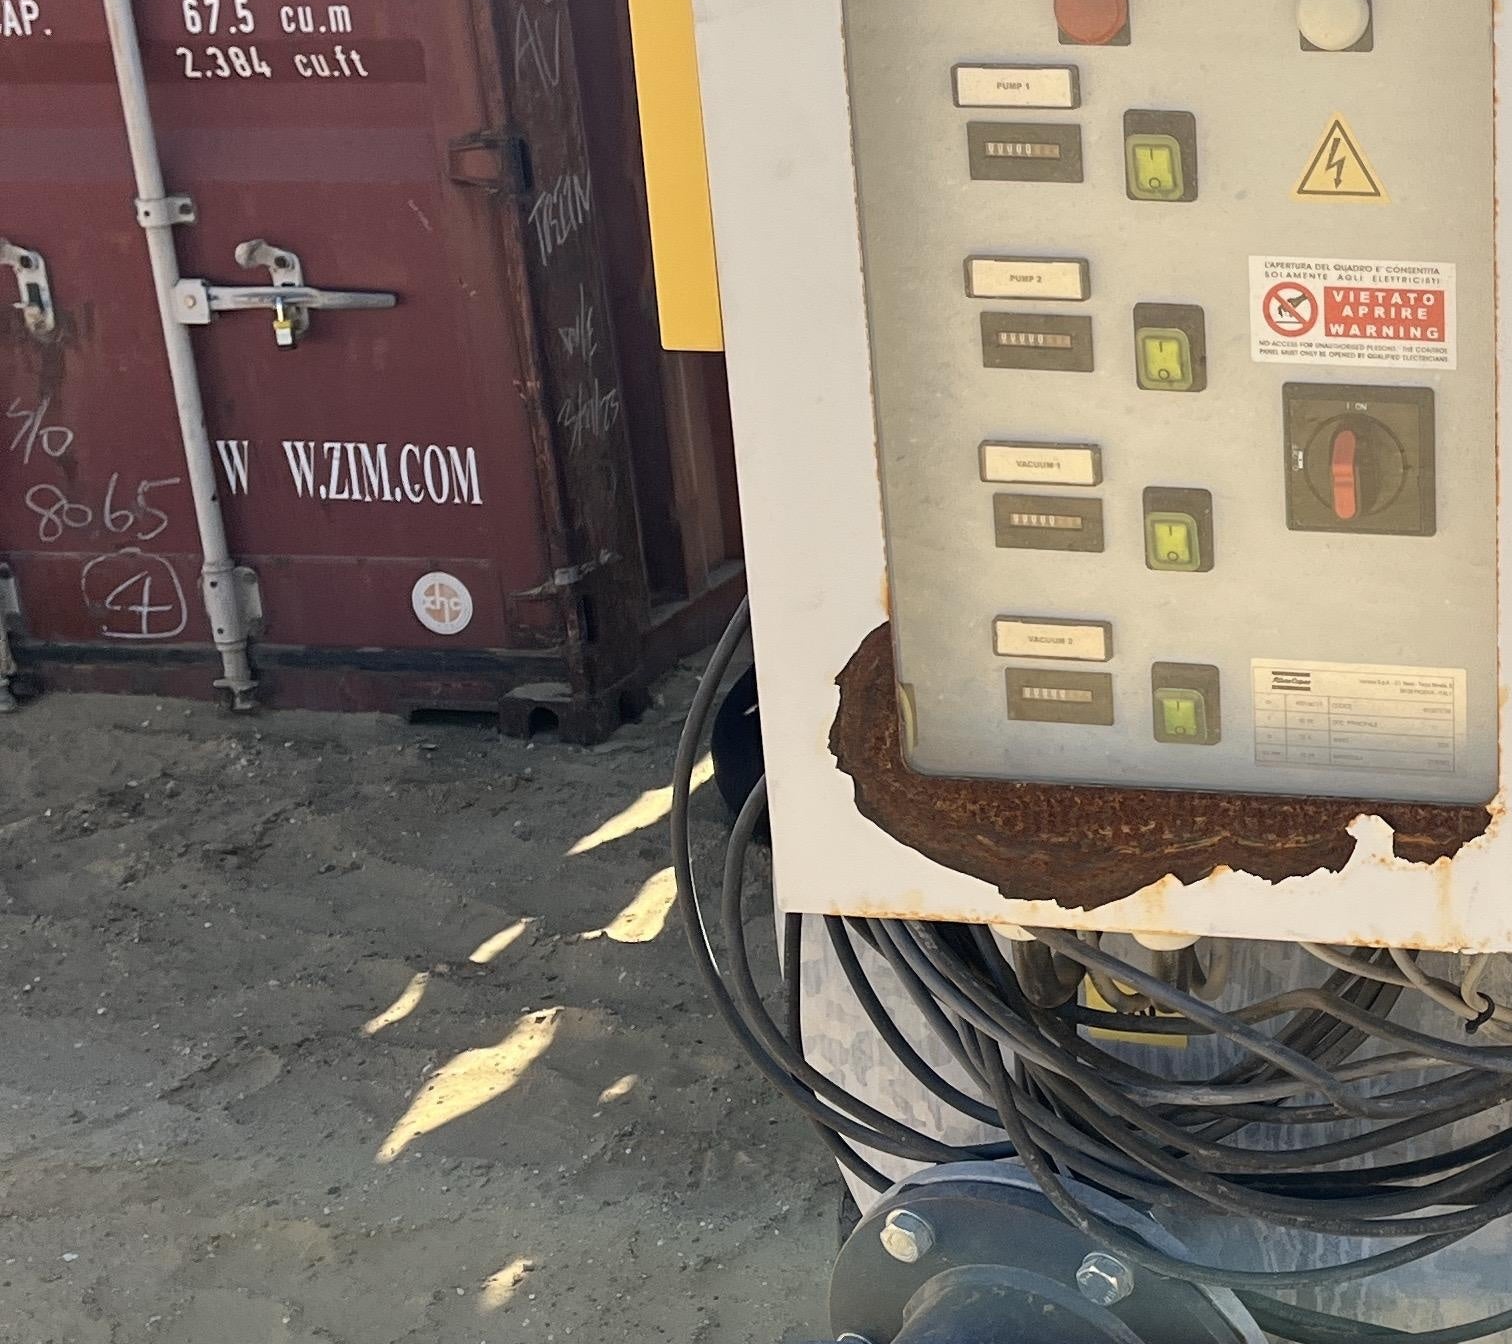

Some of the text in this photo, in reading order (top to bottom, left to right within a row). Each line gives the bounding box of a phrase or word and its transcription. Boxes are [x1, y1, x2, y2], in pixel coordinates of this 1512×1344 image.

[280, 5, 352, 33] cu.m
[175, 45, 369, 78] 2.384 cu.ft
[996, 81, 1023, 90] PUMP
[1315, 263, 1330, 271] DEL
[1333, 264, 1373, 273] QUADRO
[1385, 266, 1440, 275] CONSENTITA
[1009, 274, 1034, 283] PUMP
[1264, 271, 1328, 280] SOLAMENTE
[1332, 290, 1436, 306] VIETATO
[1341, 305, 1428, 320] APRIRE
[1328, 323, 1439, 339] WARNING
[1016, 459, 1054, 469] VACUUM
[1028, 635, 1065, 645] VACUUM
